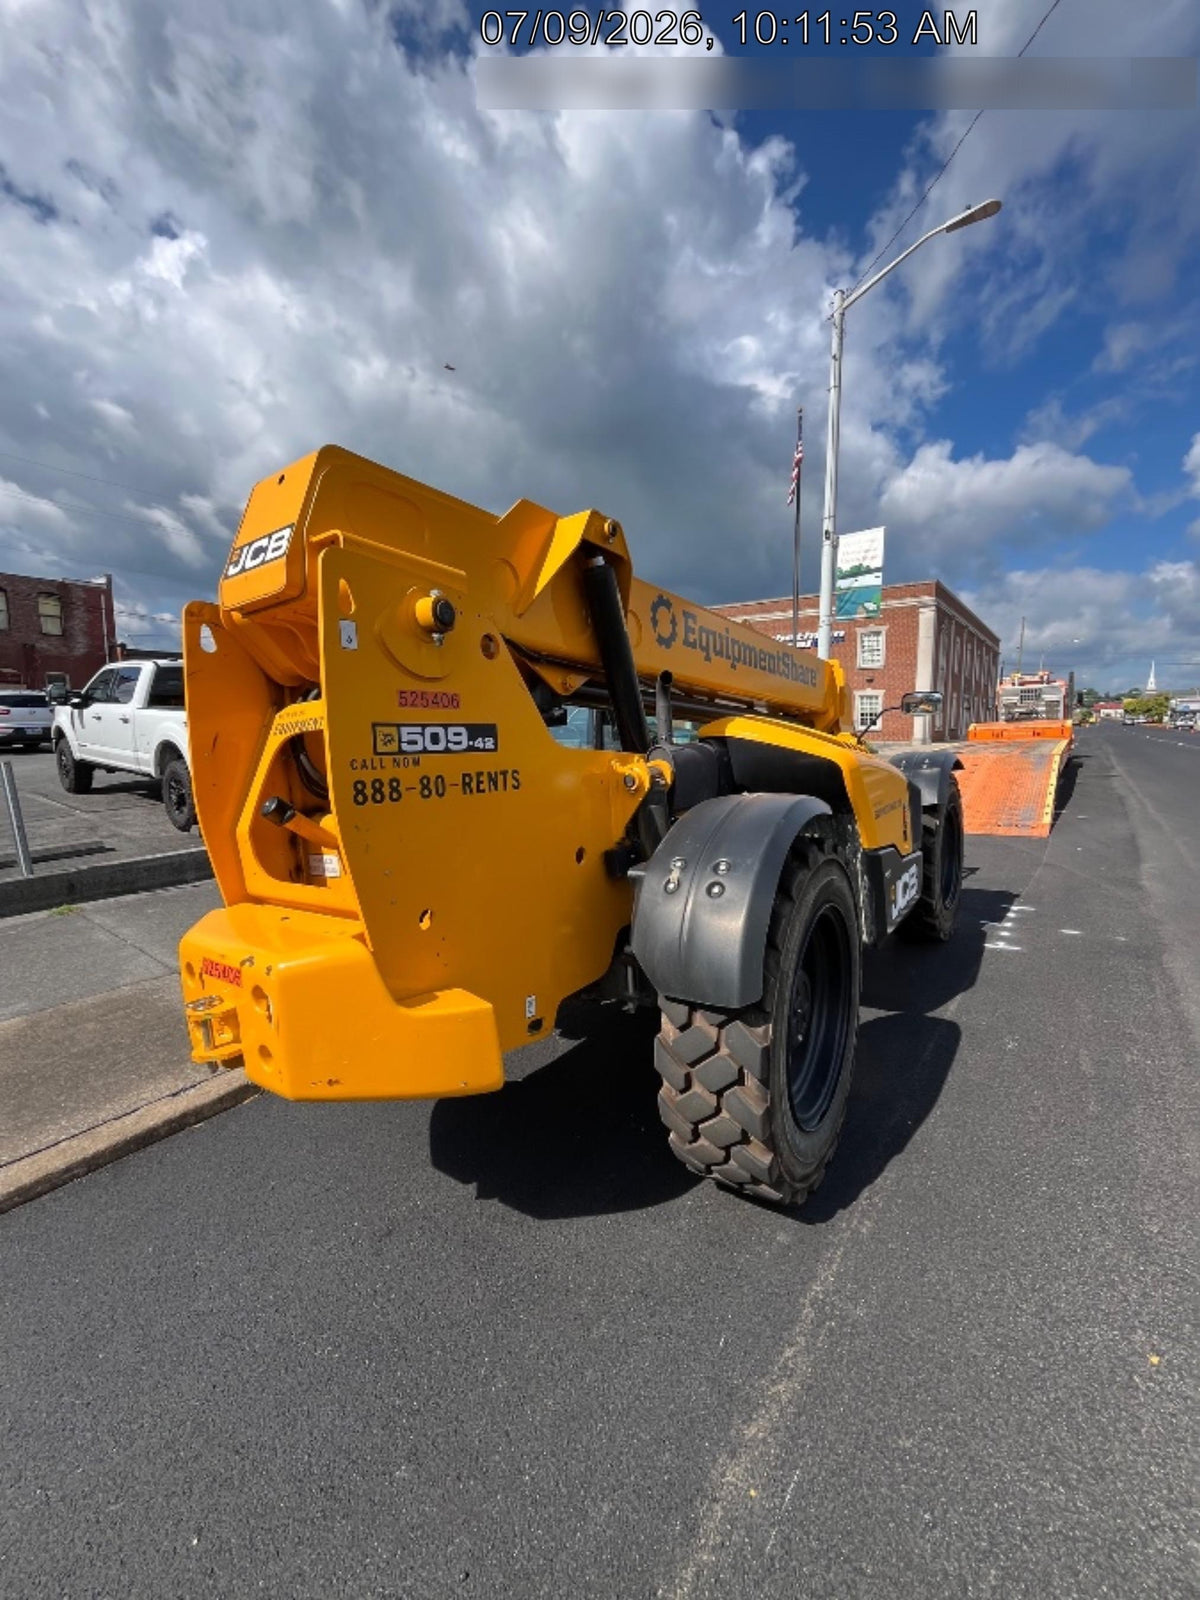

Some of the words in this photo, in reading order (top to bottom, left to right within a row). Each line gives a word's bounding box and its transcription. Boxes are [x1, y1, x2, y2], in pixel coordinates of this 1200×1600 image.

[226, 527, 292, 577] JCB
[682, 609, 817, 688] EquipmentShare
[398, 691, 460, 710] 525406
[350, 758, 386, 771] CALL
[392, 756, 421, 769] NOW
[352, 769, 521, 806] 888-80-RENTS
[891, 863, 919, 920] JCB
